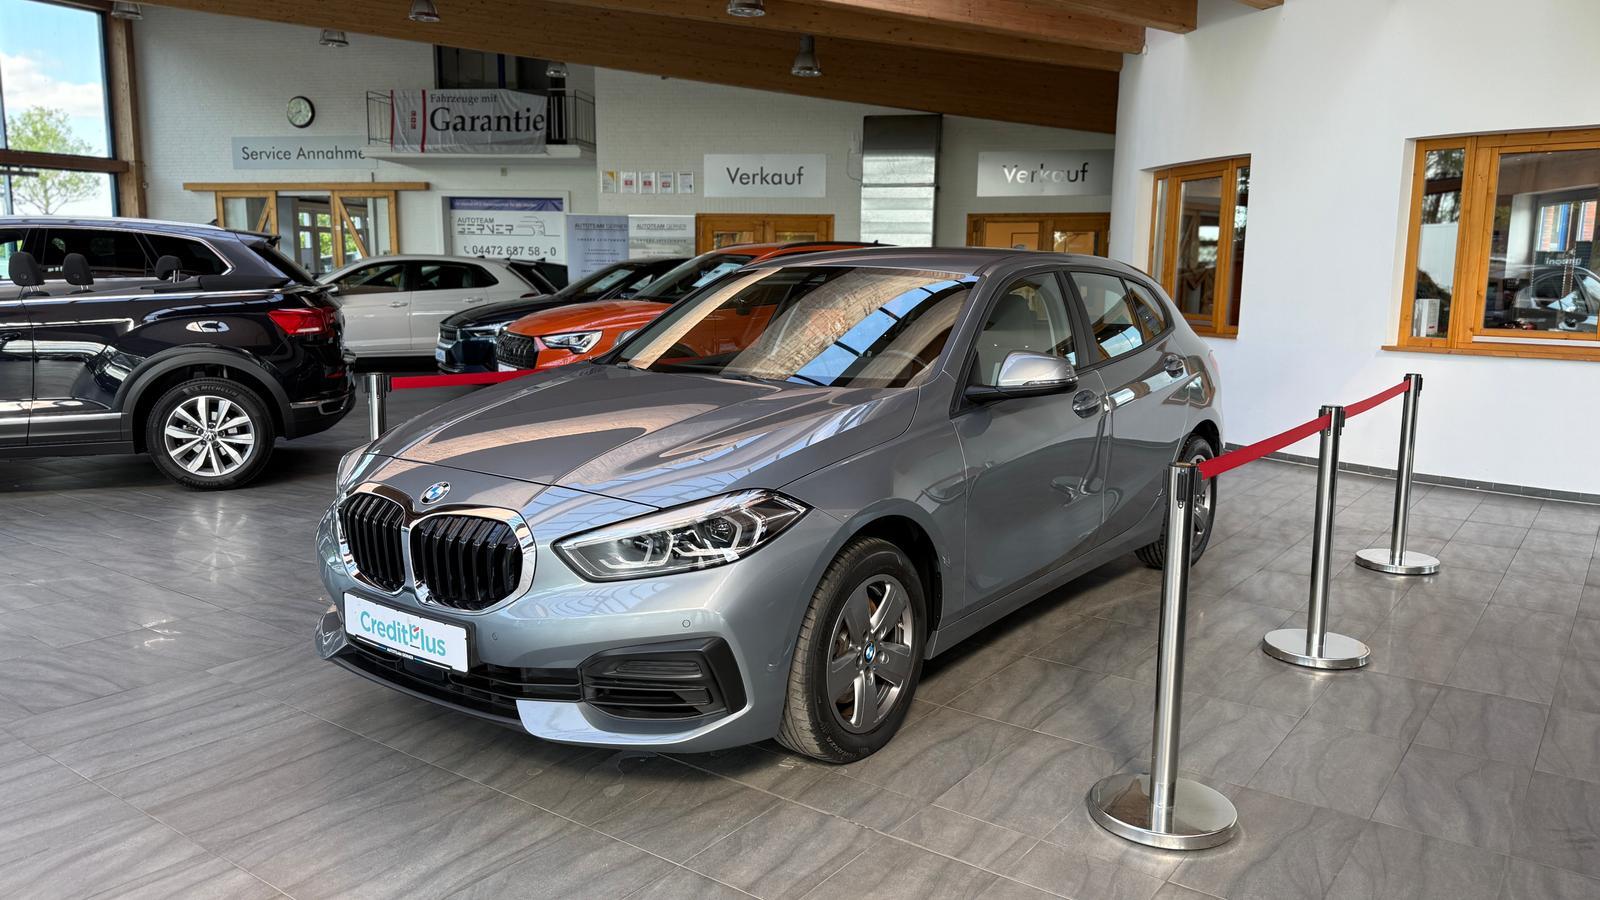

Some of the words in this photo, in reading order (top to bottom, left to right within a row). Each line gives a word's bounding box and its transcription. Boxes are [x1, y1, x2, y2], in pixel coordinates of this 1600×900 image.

[430, 93, 480, 105] Fahrzeuge
[481, 94, 498, 103] mit
[430, 106, 545, 132] Garantie
[241, 146, 291, 160] Service
[296, 145, 365, 160] Annahme
[726, 166, 804, 185] Verkauf
[1002, 162, 1089, 183] Verkauf
[472, 245, 503, 256] 04472
[506, 246, 524, 256] 687
[528, 246, 540, 256] 58
[550, 247, 557, 256] 0
[360, 610, 447, 656] CreditPlus
